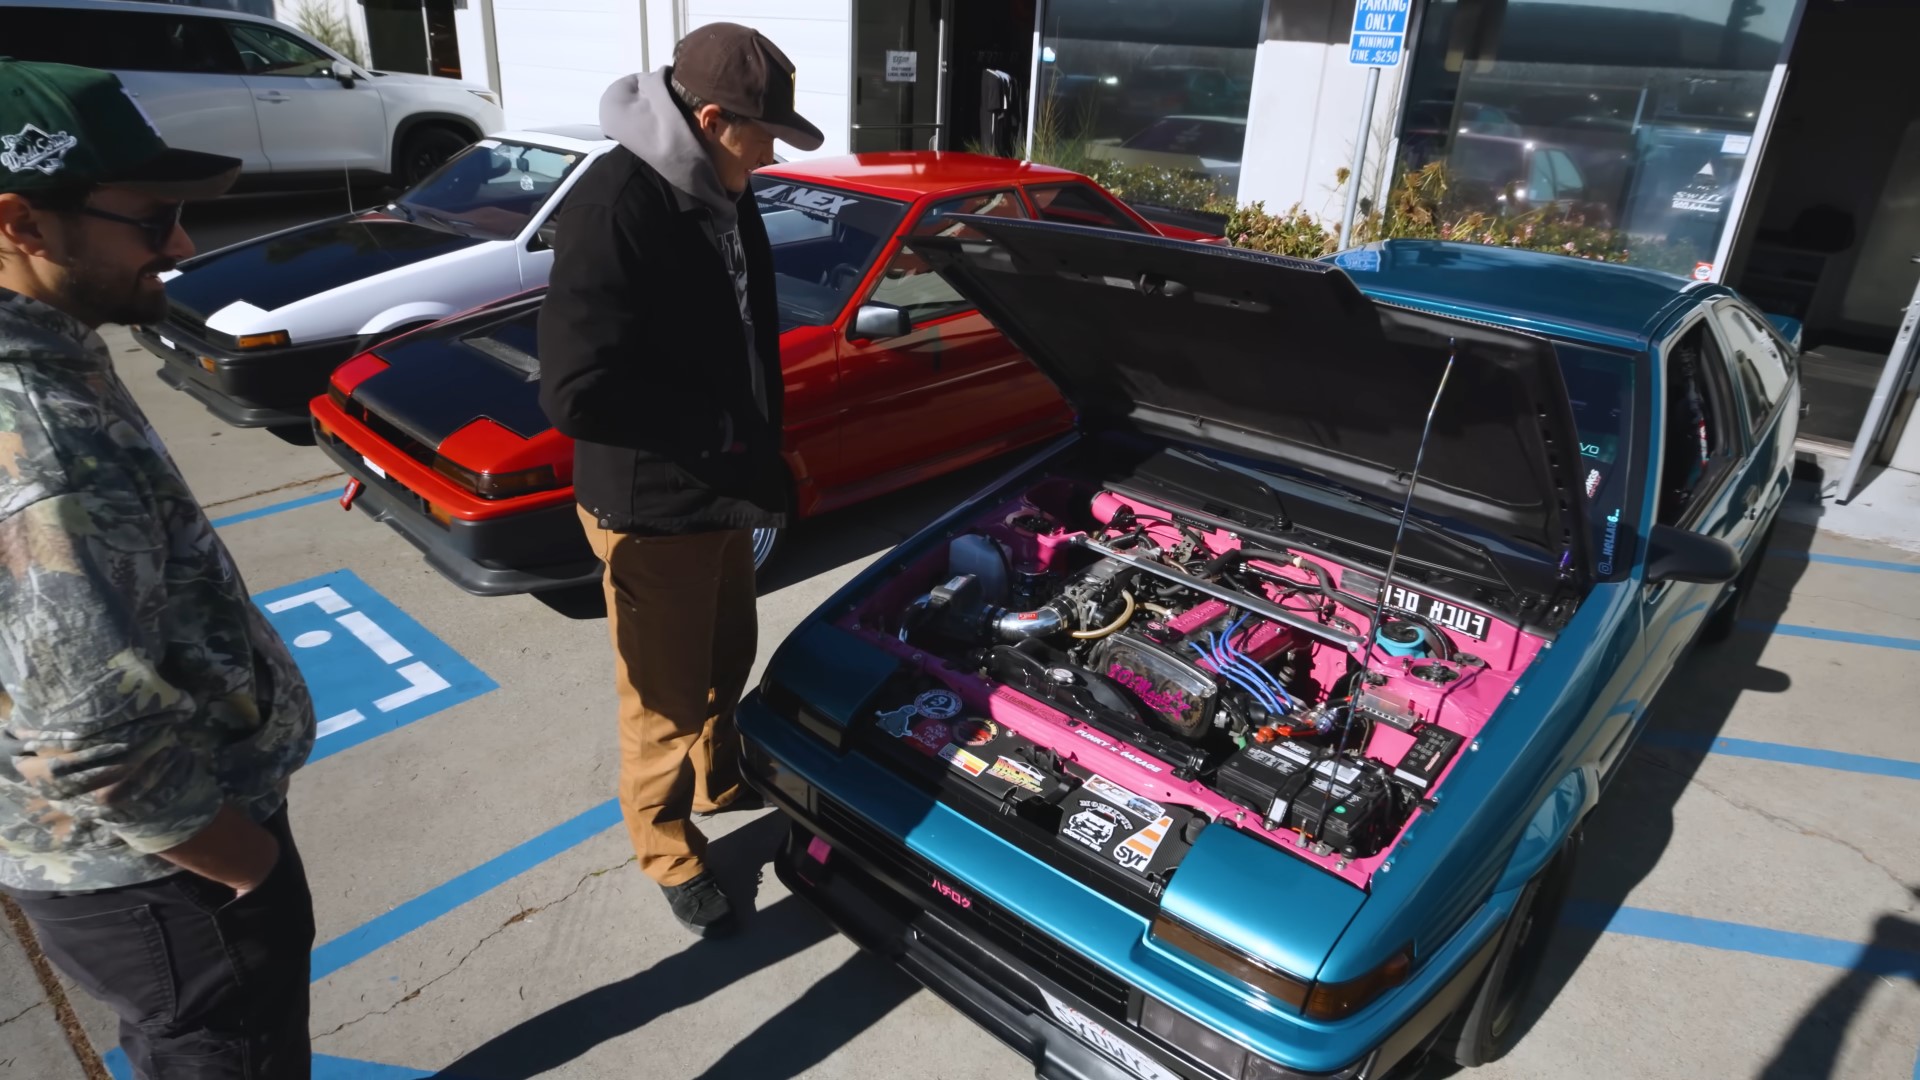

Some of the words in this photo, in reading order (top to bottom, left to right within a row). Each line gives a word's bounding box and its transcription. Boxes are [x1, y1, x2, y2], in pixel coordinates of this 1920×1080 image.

[1359, 0, 1406, 11] PARKING
[1365, 13, 1395, 31] ONLY
[1358, 36, 1394, 48] MINIMUM
[1351, 50, 1369, 62] FINE
[1075, 729, 1111, 747] FUNKY
[1120, 751, 1162, 773] GARAGE
[931, 879, 971, 908] ハチロク
